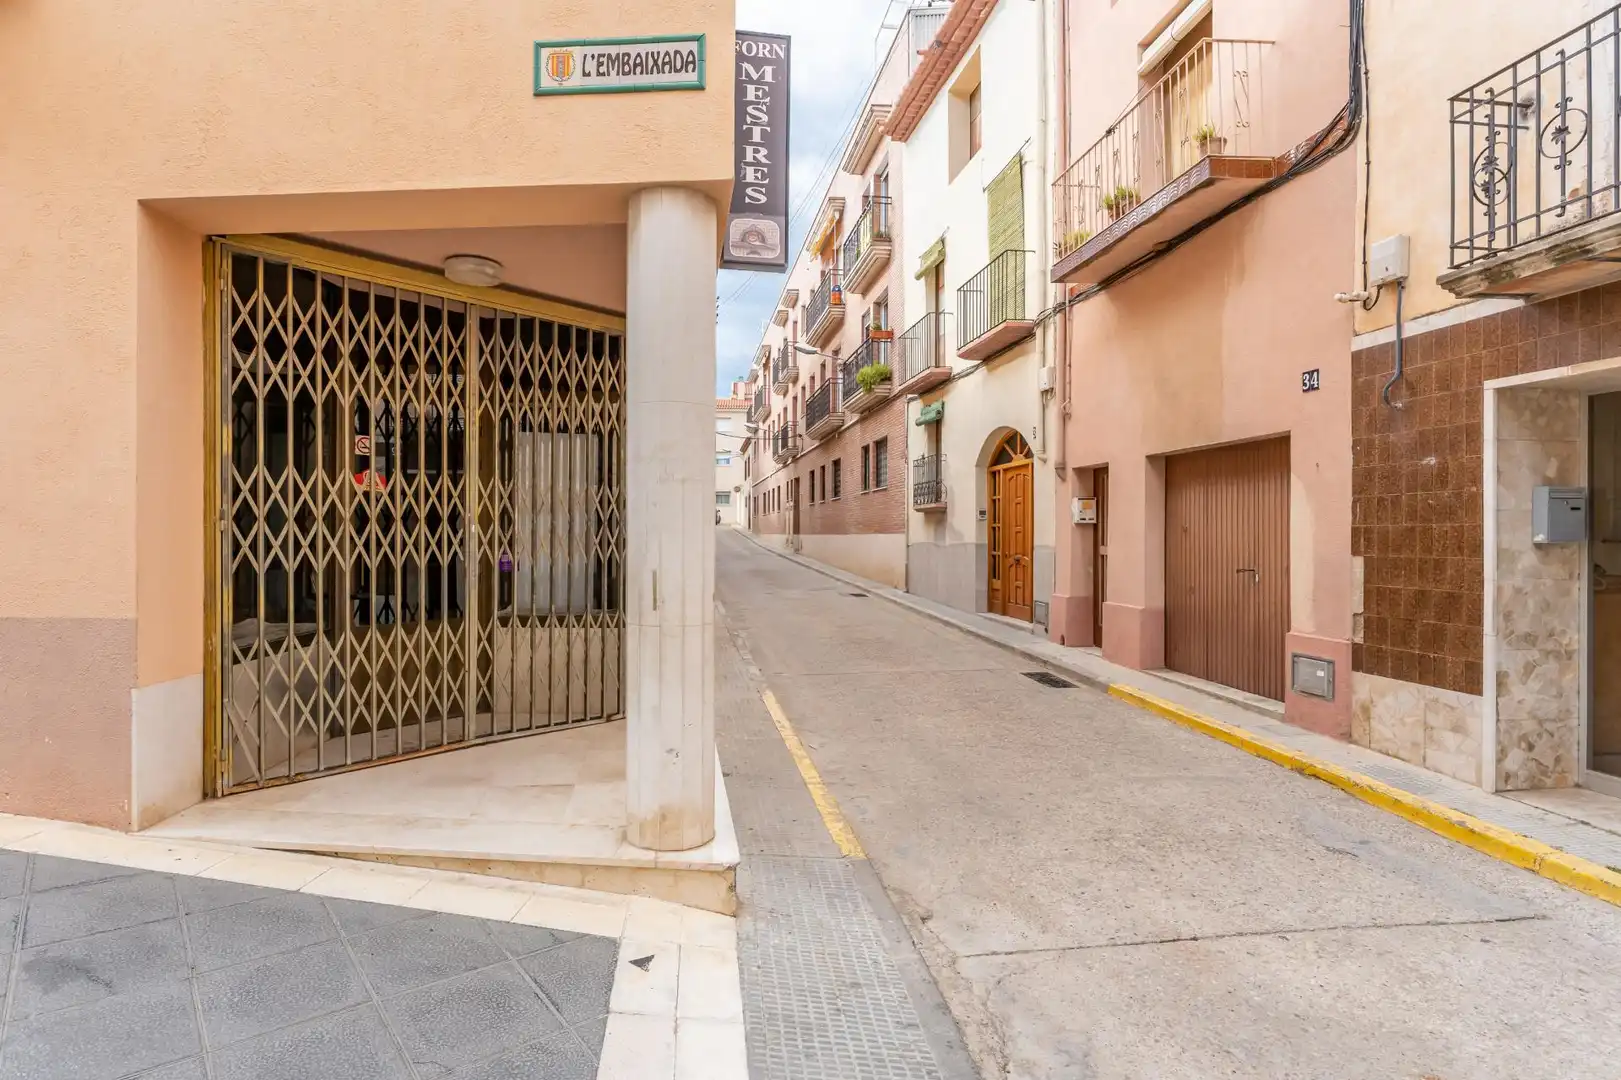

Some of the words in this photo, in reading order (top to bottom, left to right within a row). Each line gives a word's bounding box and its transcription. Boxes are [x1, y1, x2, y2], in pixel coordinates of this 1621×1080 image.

[582, 50, 697, 77] L'EMBAIXADA
[739, 62, 776, 204] MESTRES
[1303, 371, 1319, 390] 34
